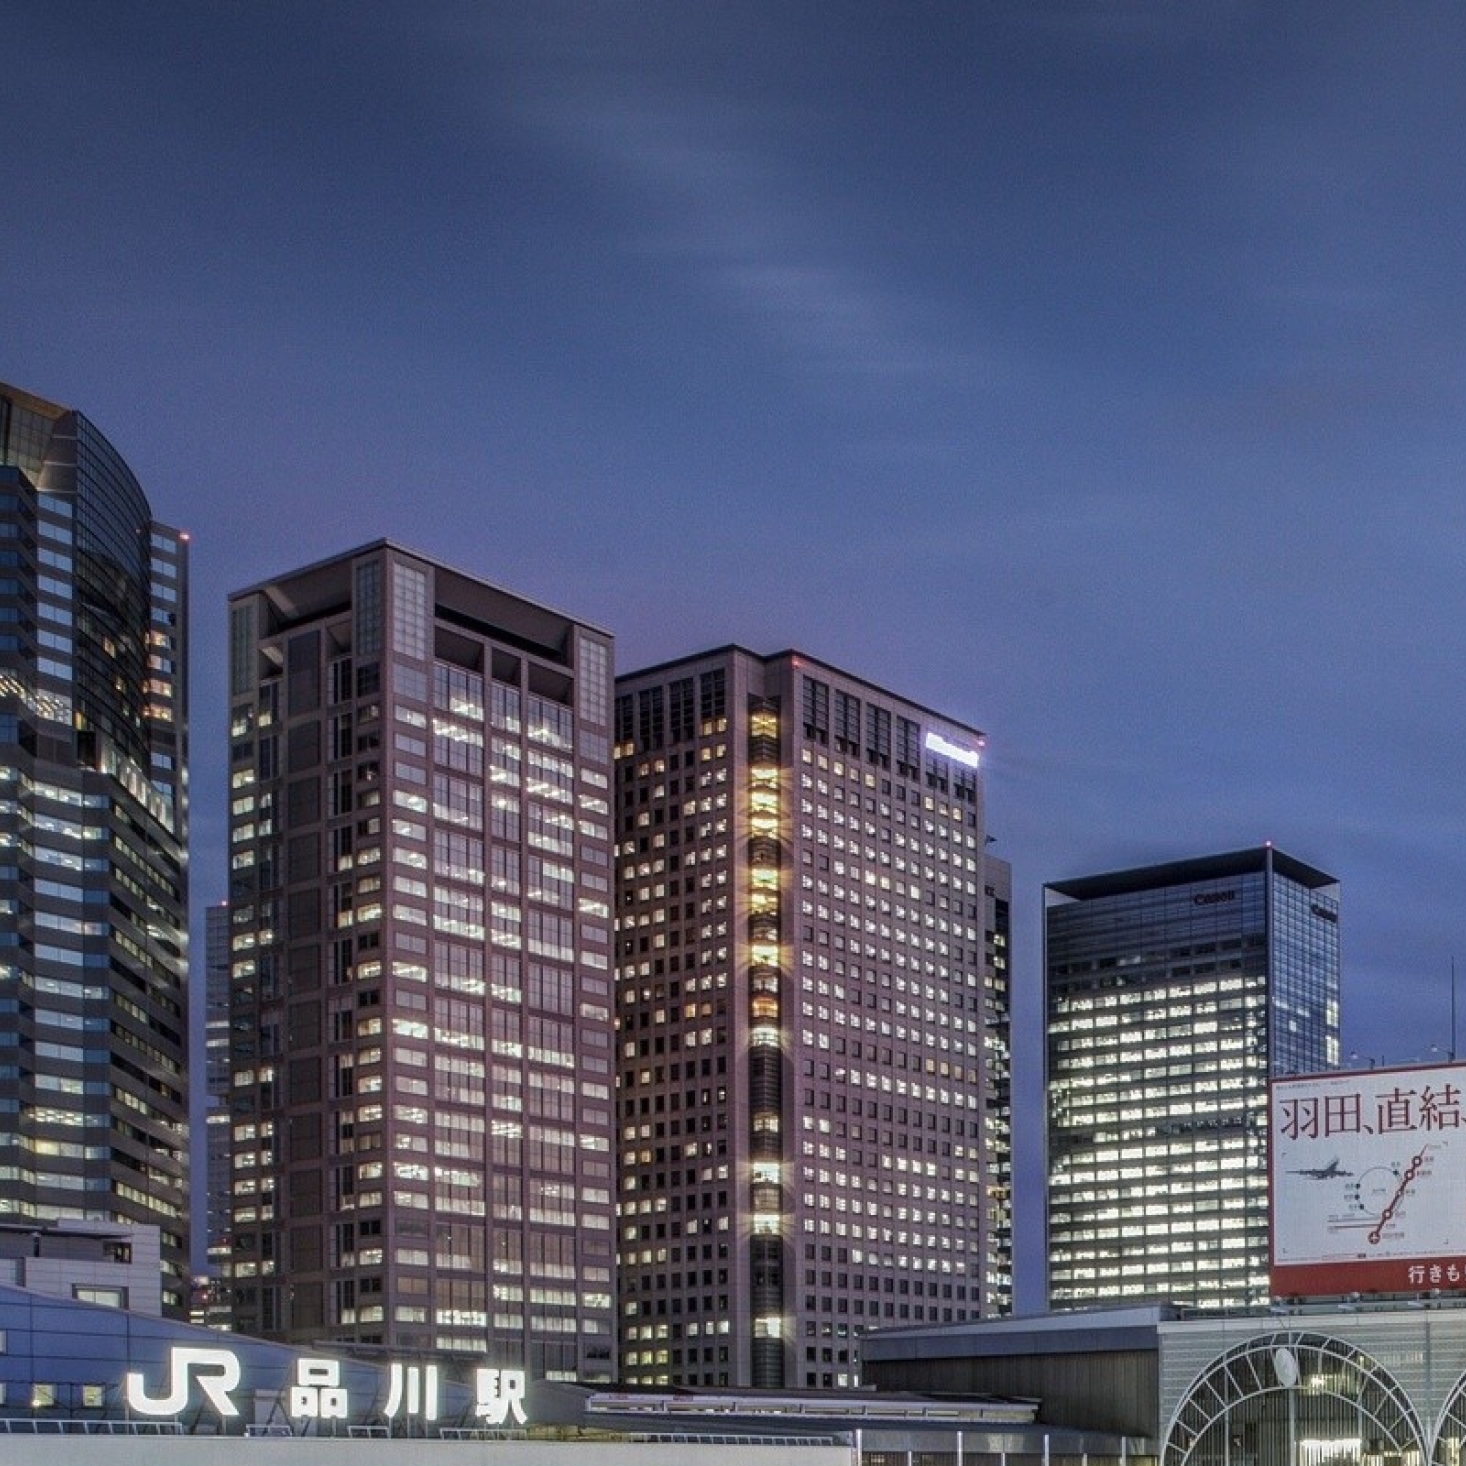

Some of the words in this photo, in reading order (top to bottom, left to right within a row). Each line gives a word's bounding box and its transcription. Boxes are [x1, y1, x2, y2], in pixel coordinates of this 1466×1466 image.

[126, 1346, 241, 1416] JR
[291, 1357, 528, 1425] 品川駅
